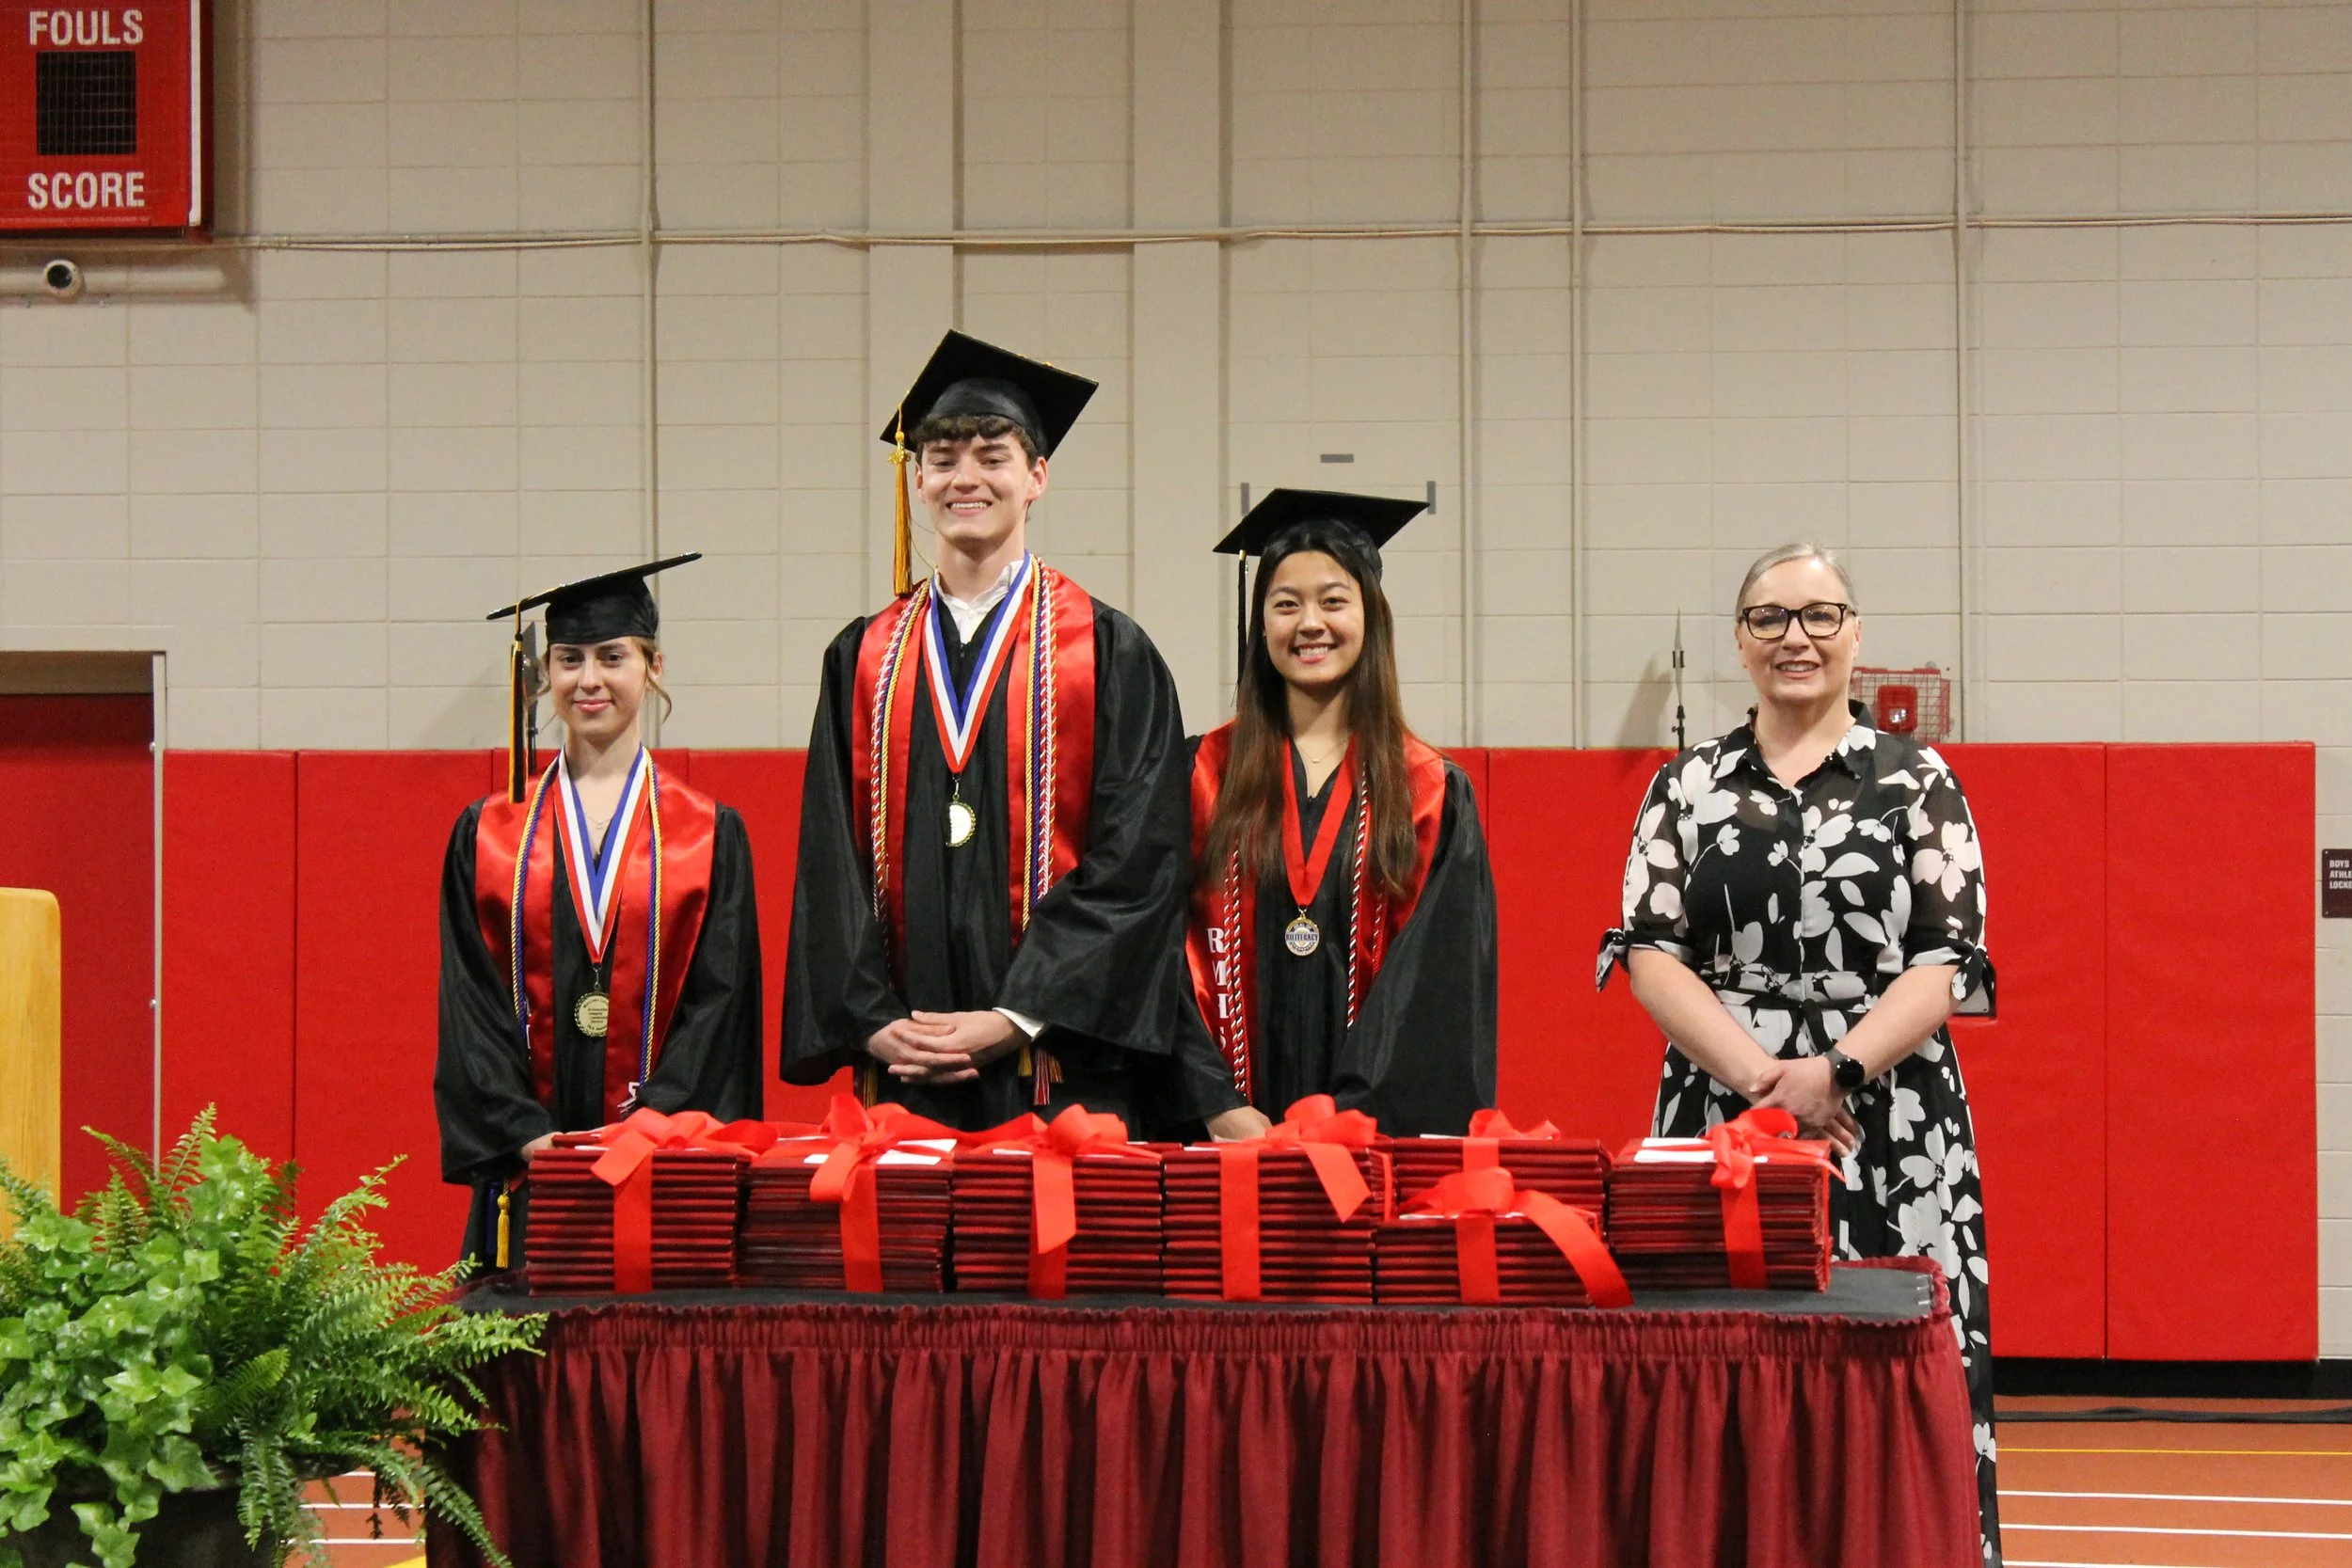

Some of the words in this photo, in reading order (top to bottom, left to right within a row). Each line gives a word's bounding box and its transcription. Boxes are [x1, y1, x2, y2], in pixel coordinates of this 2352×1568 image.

[29, 9, 143, 45] FOULS
[28, 171, 145, 210] SCORE
[2329, 860, 2350, 868] BOYS
[1285, 933, 1318, 942] BILITERACY
